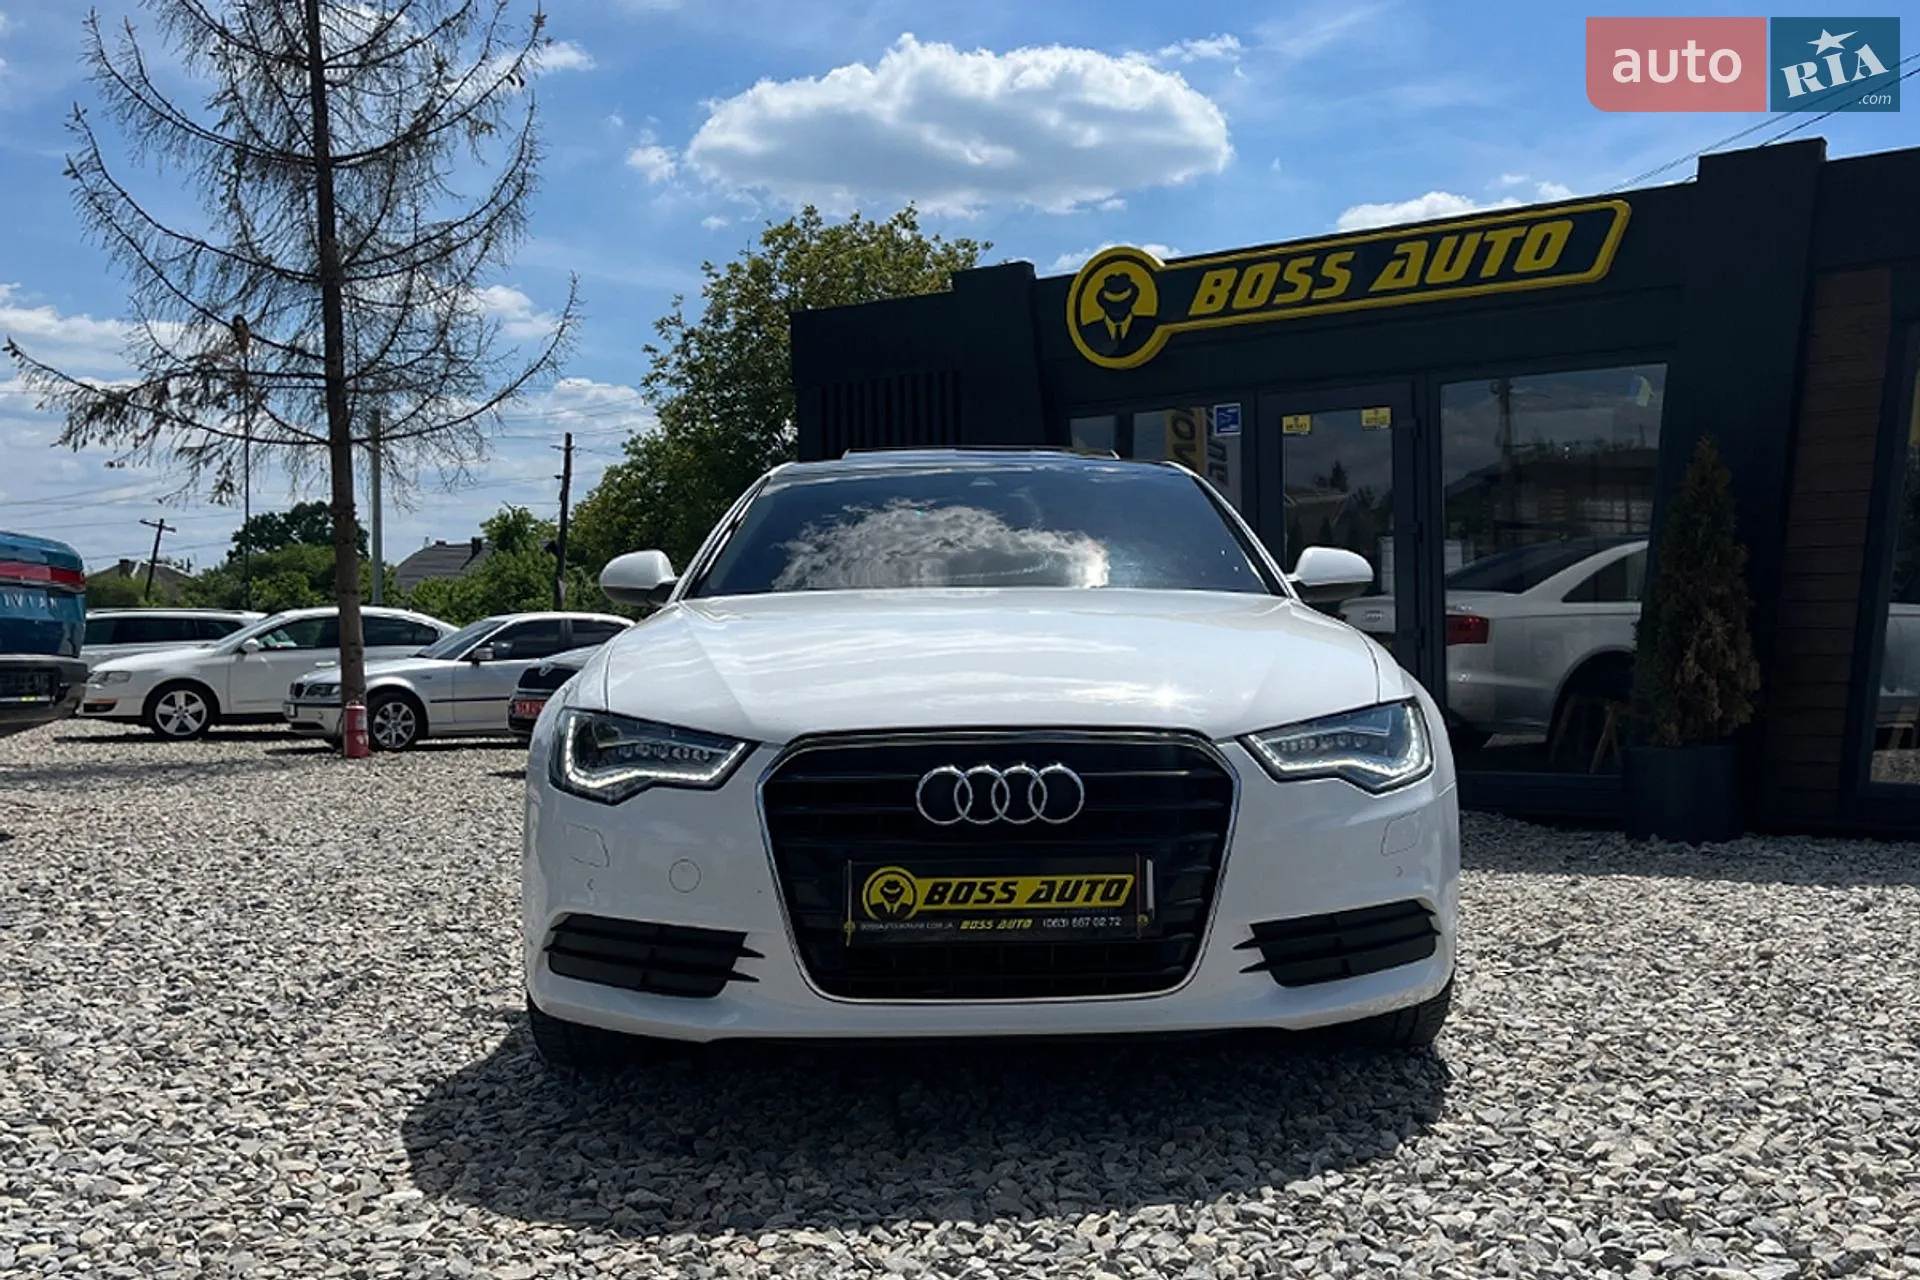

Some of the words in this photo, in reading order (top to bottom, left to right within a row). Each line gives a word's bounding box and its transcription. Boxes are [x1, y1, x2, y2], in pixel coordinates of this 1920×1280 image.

[1188, 251, 1355, 317] BOSS
[1369, 219, 1574, 292] AUTO
[923, 880, 1020, 906] BOSS
[1025, 878, 1129, 904] AUTO
[959, 920, 993, 930] BOSS
[996, 919, 1033, 930] AUTO
